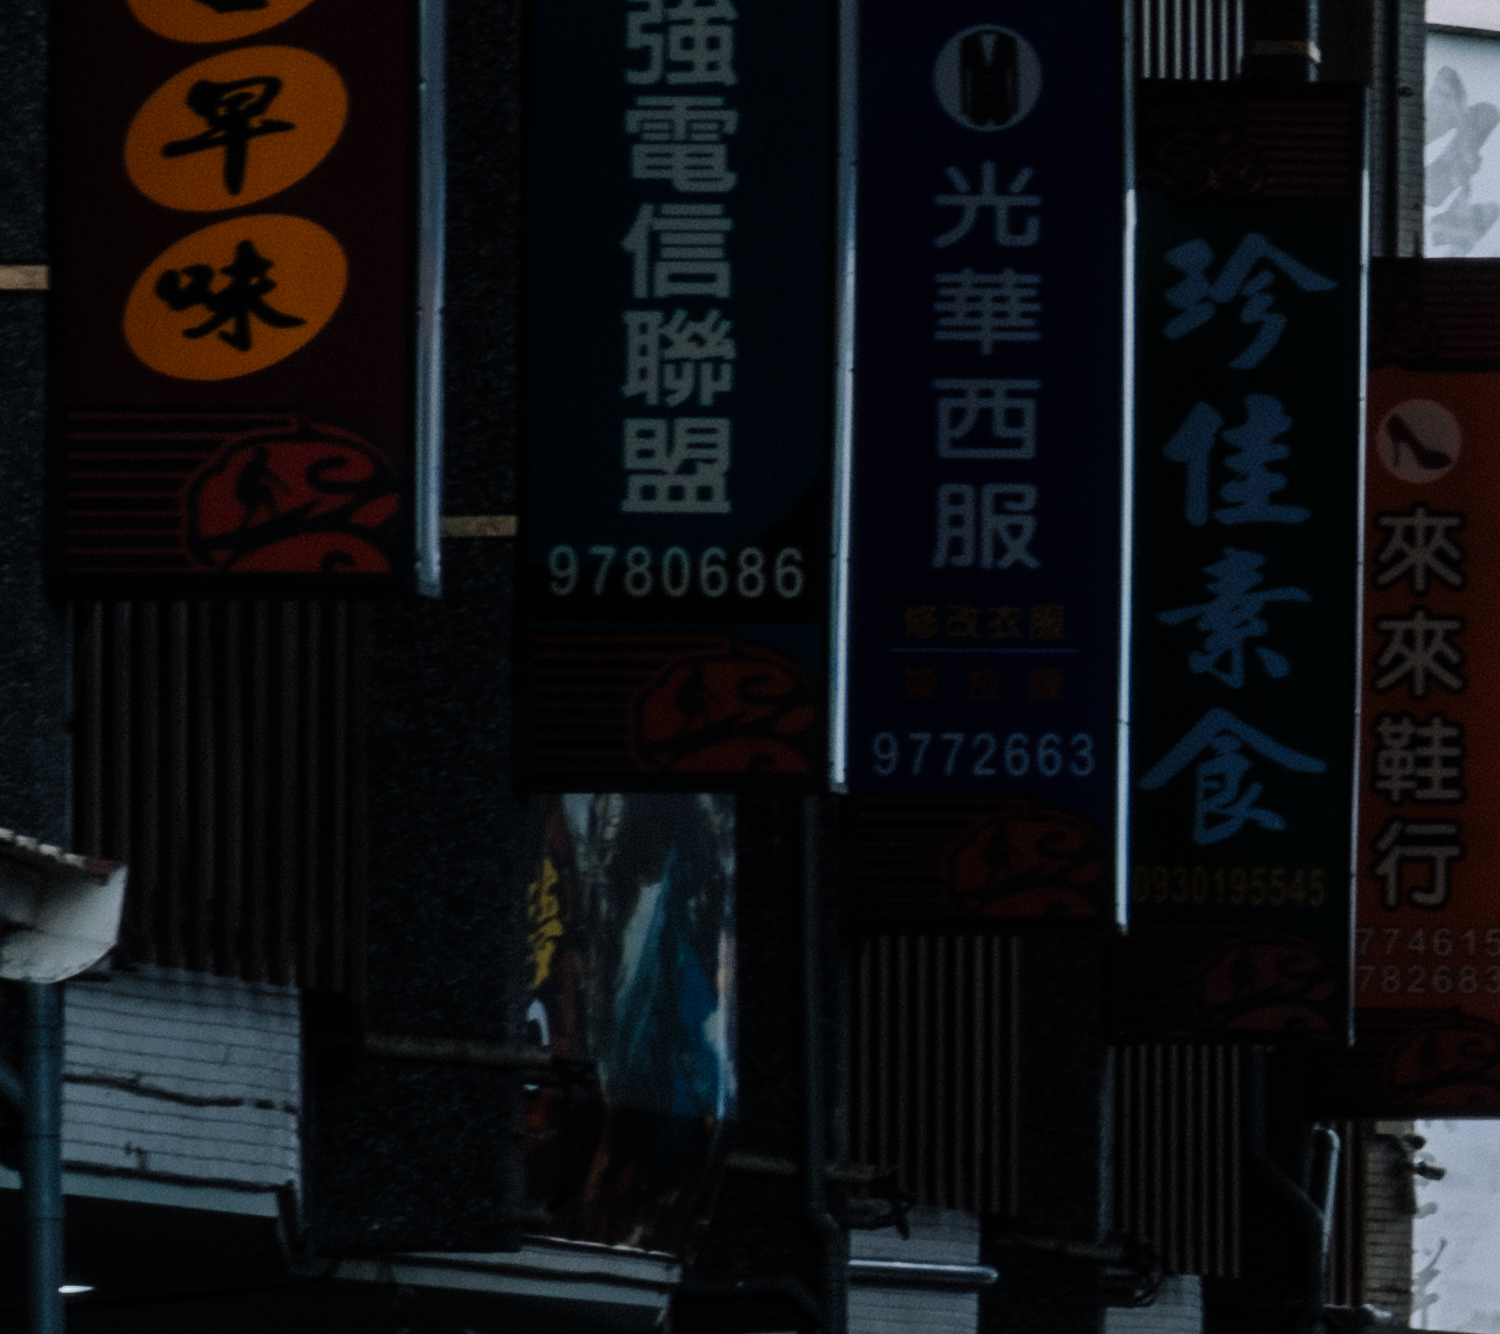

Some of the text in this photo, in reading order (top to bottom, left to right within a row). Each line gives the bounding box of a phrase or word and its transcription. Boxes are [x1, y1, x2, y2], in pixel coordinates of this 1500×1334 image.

[931, 160, 1044, 571] 光華西服
[1138, 232, 1339, 848] 珍佳素食
[546, 545, 807, 601] 9780686
[871, 731, 1096, 779] 9772663
[1372, 504, 1464, 910] 來來鞋行
